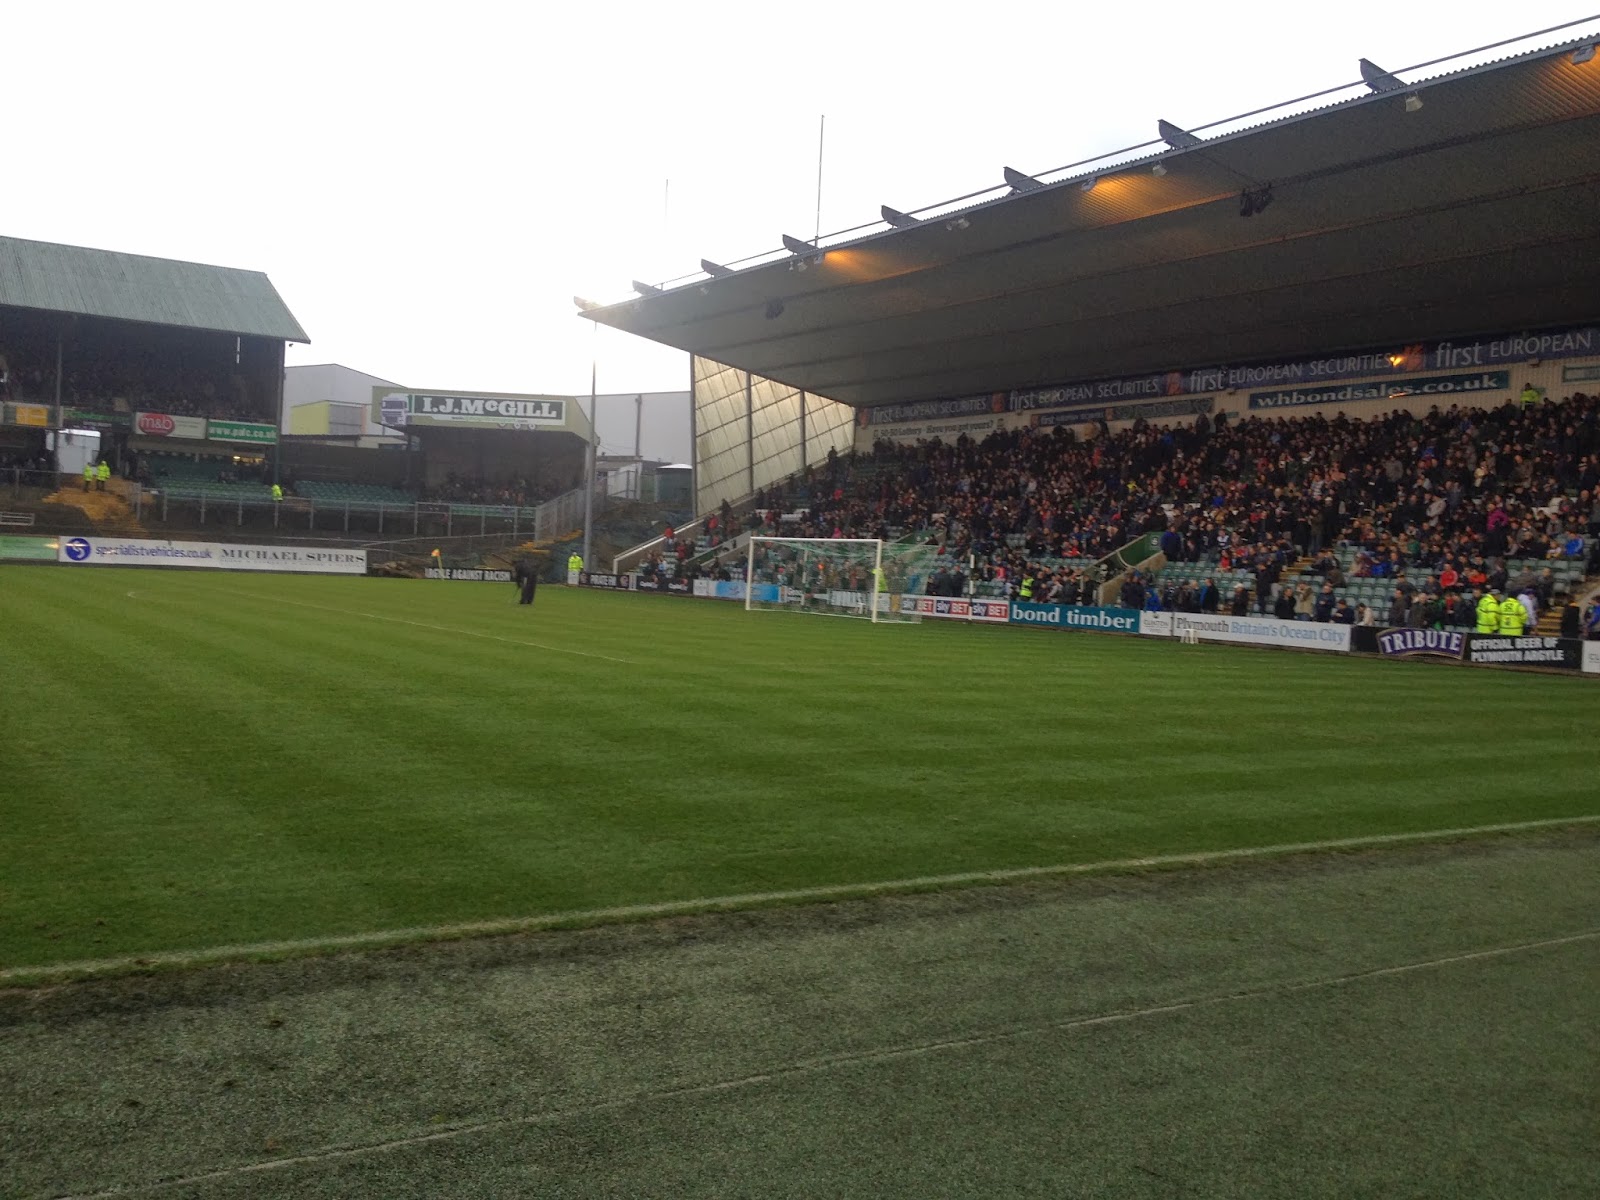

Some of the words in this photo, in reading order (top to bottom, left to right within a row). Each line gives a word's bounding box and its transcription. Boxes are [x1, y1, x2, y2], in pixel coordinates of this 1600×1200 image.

[1436, 342, 1483, 367] first
[1490, 332, 1592, 358] EUROPEAN
[1189, 370, 1224, 392] first
[1229, 364, 1303, 384] EUROPEAN
[1309, 353, 1391, 376] SECURITIES
[1009, 391, 1035, 410] first
[1098, 379, 1159, 398] SECURITIES
[1257, 375, 1498, 406] whbondsales.co.uk
[141, 417, 172, 430] m&b
[221, 549, 302, 561] MICHAEL
[306, 552, 365, 563] SPIERS
[451, 569, 483, 580] AGAINST
[484, 570, 511, 581] RACISM
[902, 598, 915, 611] sky
[916, 600, 934, 612] BET
[936, 600, 950, 613] sky
[952, 601, 969, 613] BET
[973, 602, 987, 616] sky
[988, 603, 1007, 616] BET
[1012, 604, 1060, 624] bond
[1066, 608, 1135, 629] timber
[1176, 617, 1229, 633] Plymouth
[1231, 621, 1277, 635] Britain's
[1279, 626, 1317, 640] Ocean
[1320, 628, 1346, 645] City
[1380, 630, 1462, 653] TRIBUTE
[1470, 638, 1514, 650] OFFICIAL
[1515, 637, 1543, 649] BEER
[1543, 637, 1559, 648] OF
[1470, 650, 1524, 662] PLYMOUTH
[1523, 650, 1565, 661] ARGYLE
